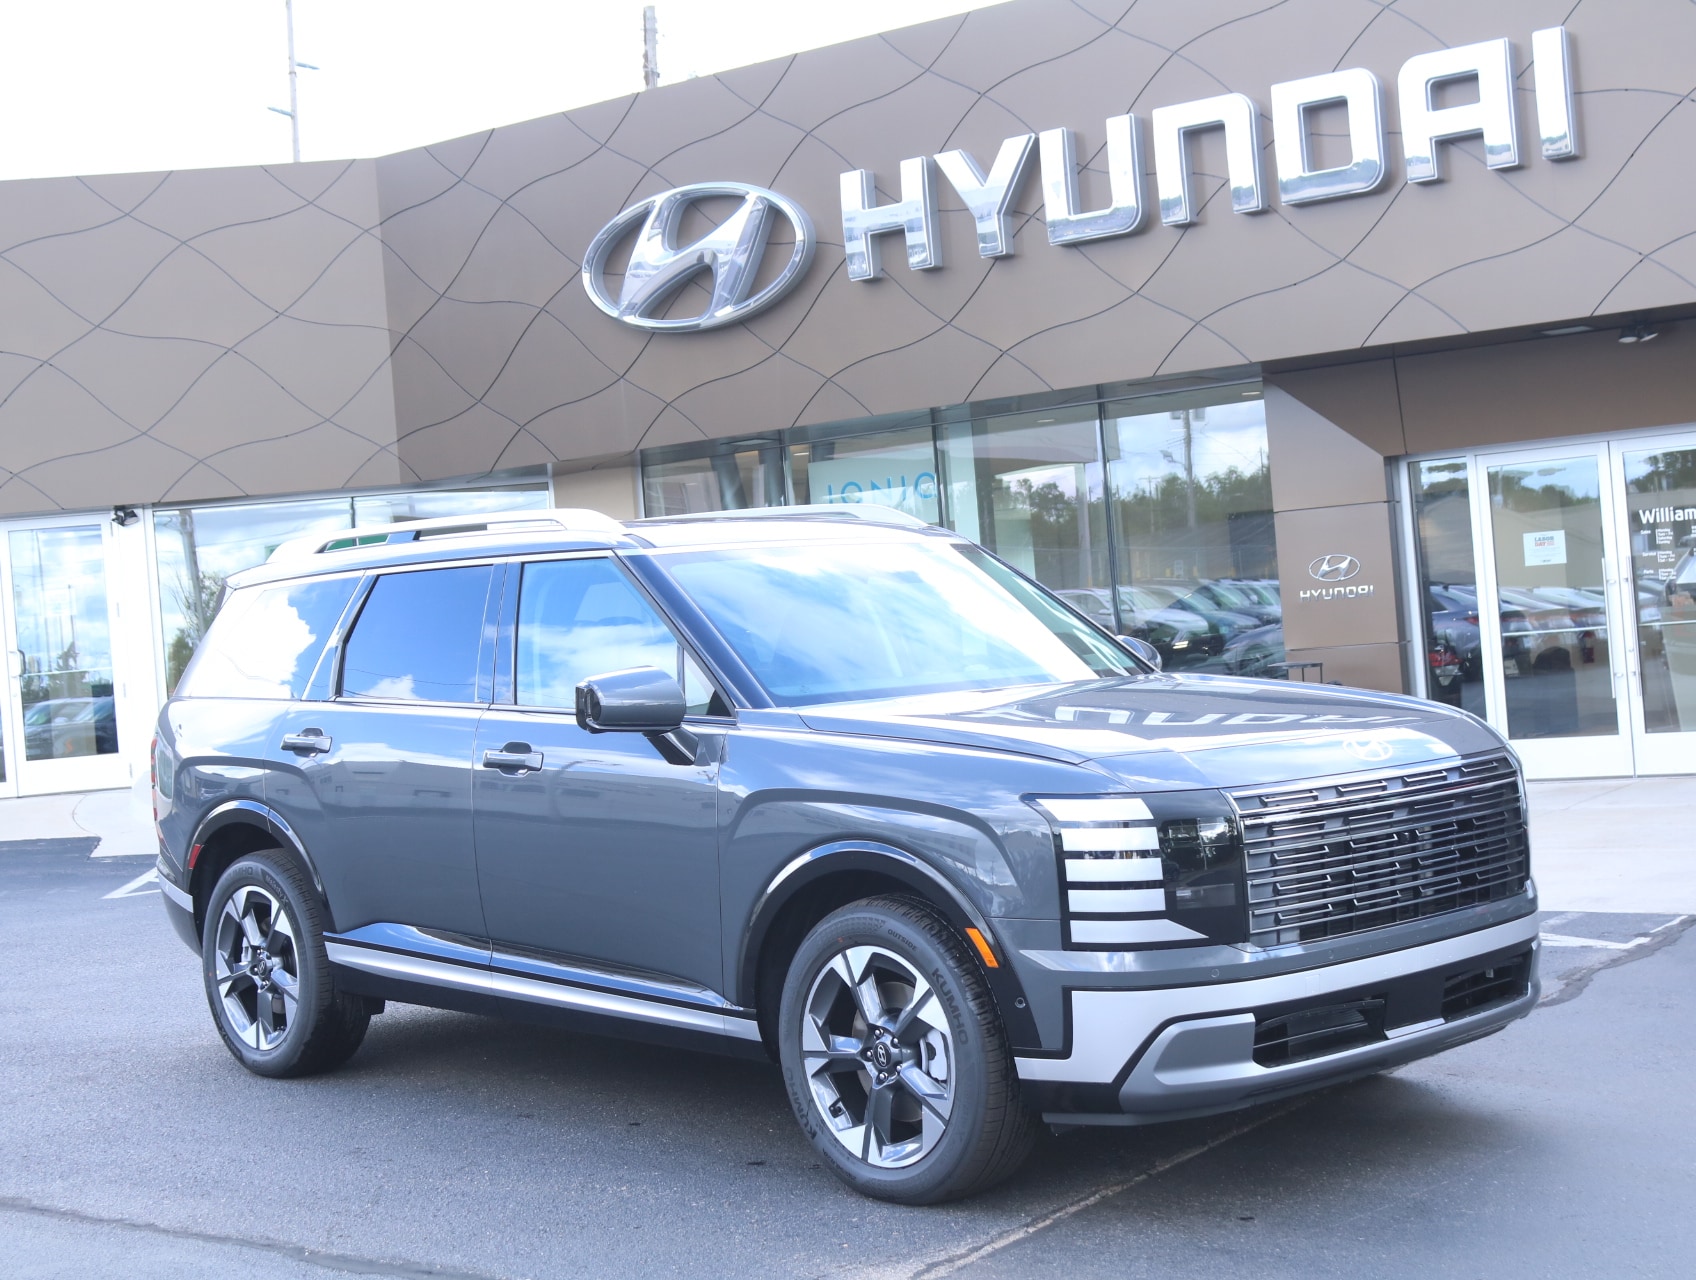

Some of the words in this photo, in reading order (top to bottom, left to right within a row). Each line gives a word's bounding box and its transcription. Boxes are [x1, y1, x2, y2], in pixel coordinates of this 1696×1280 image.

[840, 26, 1582, 282] HYUNDAI
[1299, 584, 1374, 602] HYUNDAI
[887, 928, 917, 951] OUTSIDE
[931, 967, 969, 1046] KUMHO
